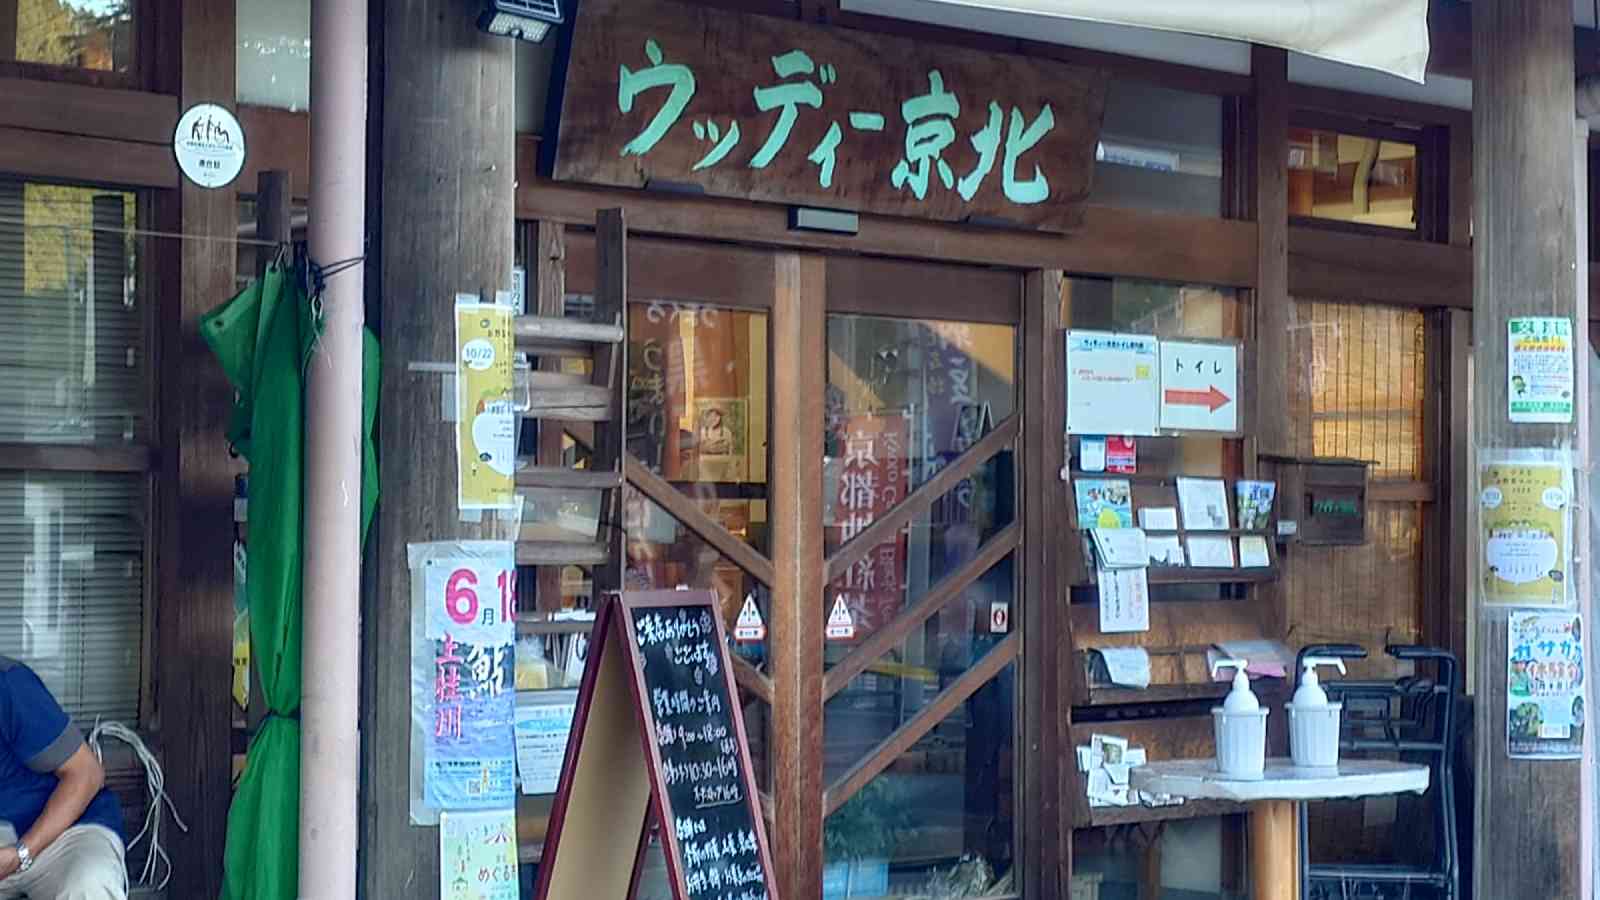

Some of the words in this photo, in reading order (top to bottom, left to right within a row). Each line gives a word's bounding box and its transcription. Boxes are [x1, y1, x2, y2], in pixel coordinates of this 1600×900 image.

[618, 39, 1056, 204] ウッディー京北
[465, 347, 493, 360] 10/22
[1175, 357, 1223, 375] トイレ
